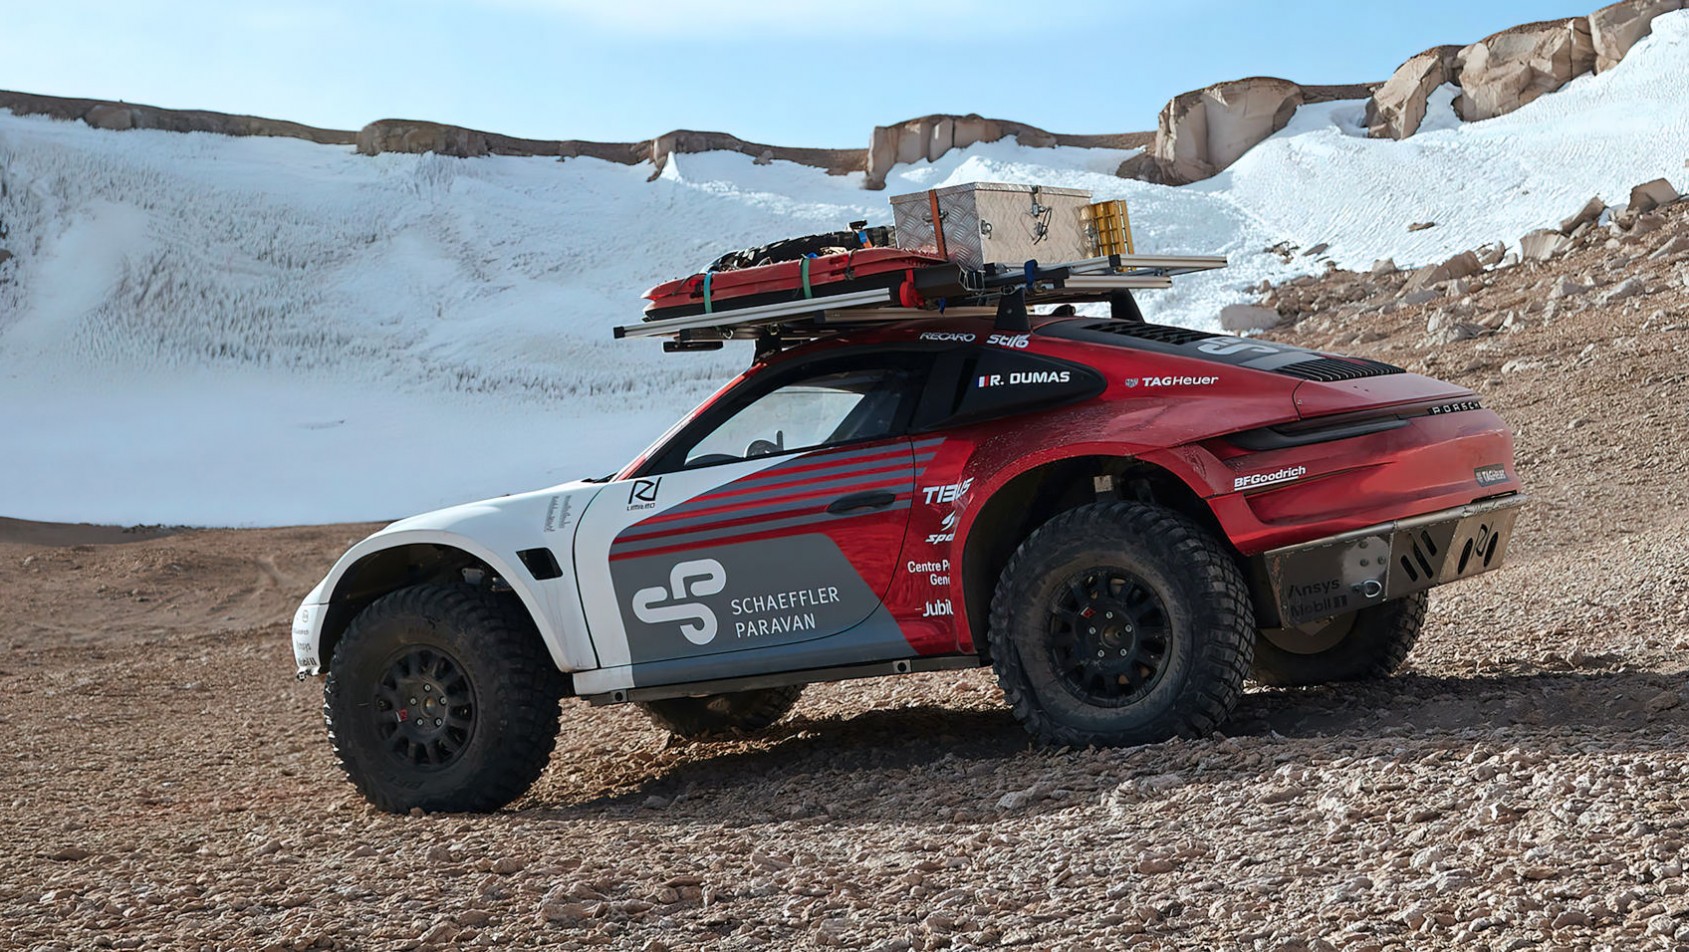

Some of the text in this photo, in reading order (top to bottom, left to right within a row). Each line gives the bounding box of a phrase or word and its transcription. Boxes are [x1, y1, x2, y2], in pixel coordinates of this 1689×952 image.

[919, 332, 976, 342] RECARO
[990, 371, 1071, 387] R. DUMAS
[1234, 465, 1306, 489] BFGoodrich
[907, 560, 941, 573] Centre
[1289, 579, 1340, 599] Ansys
[731, 586, 840, 616] SCHAEFFLER
[735, 612, 817, 639] PARAVAN
